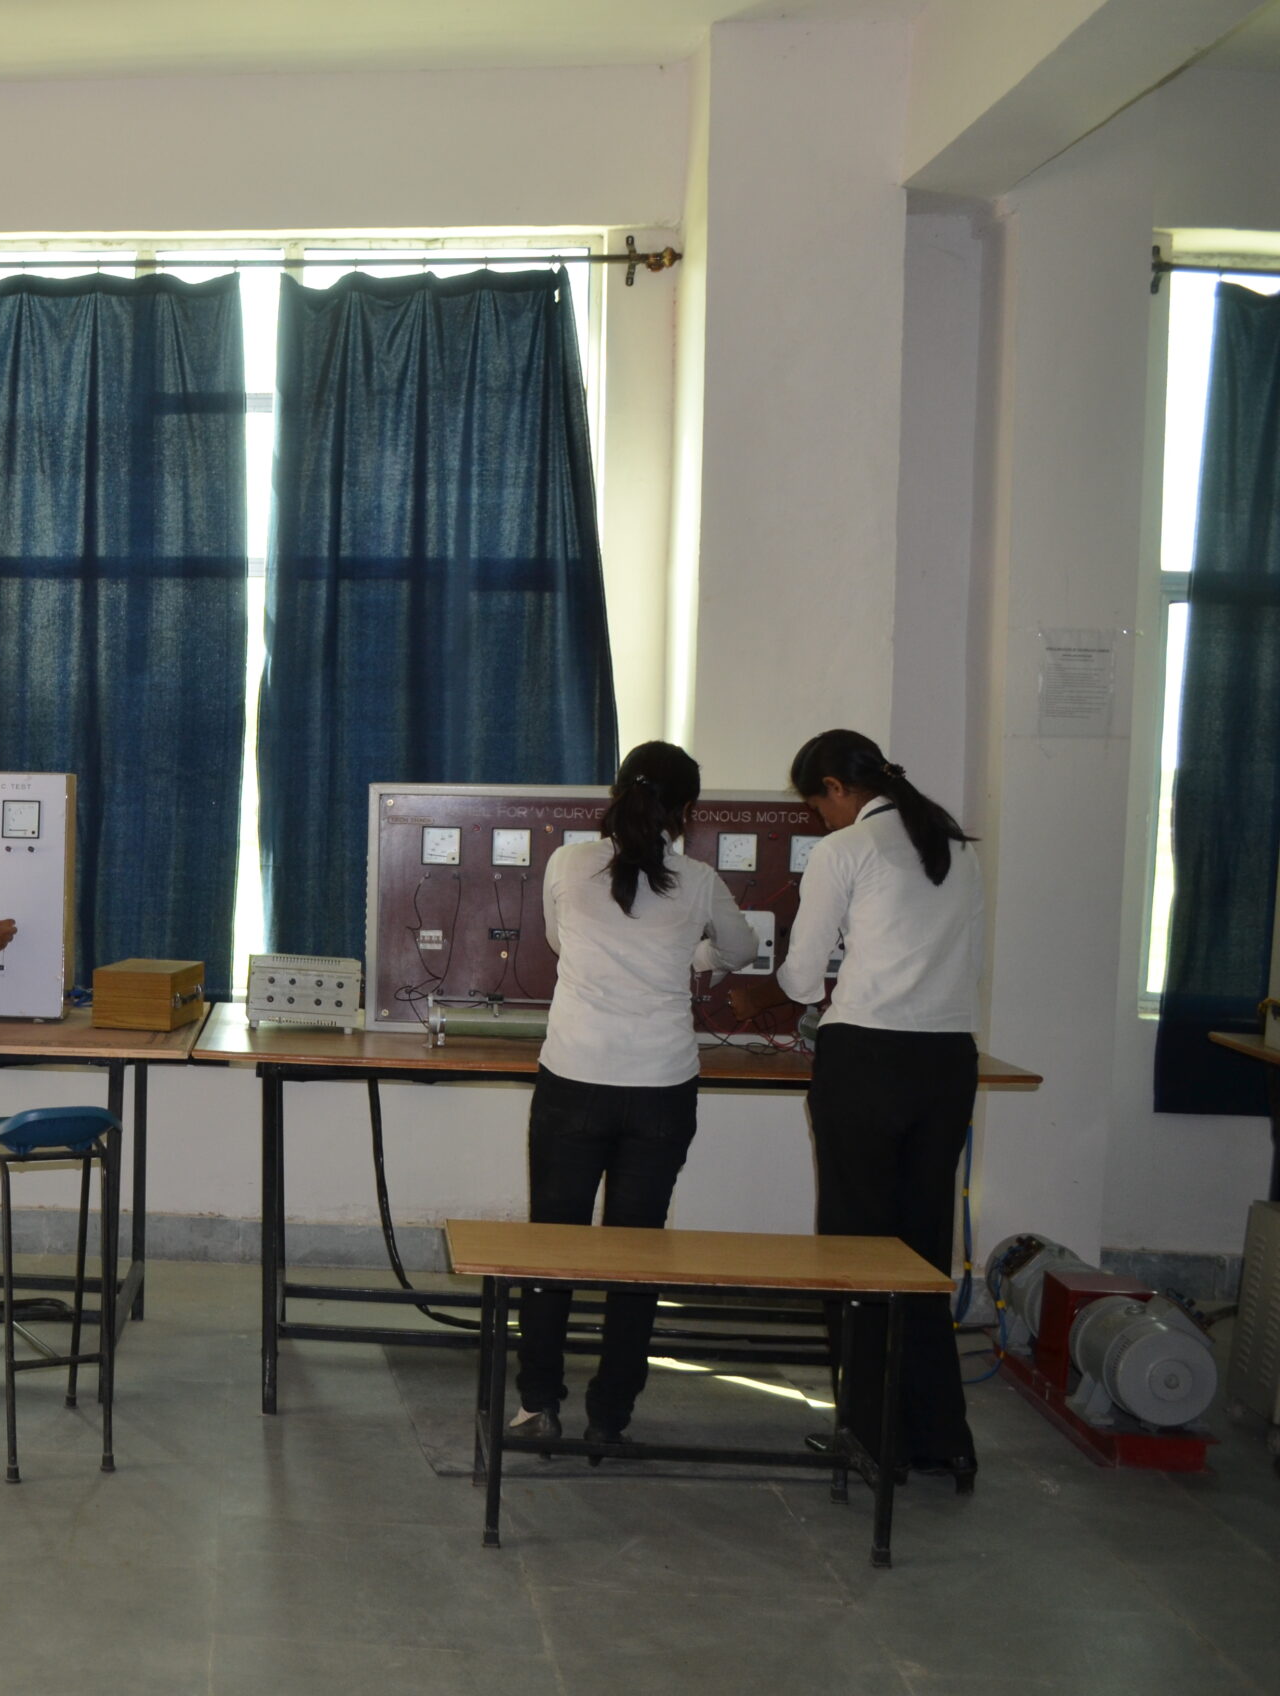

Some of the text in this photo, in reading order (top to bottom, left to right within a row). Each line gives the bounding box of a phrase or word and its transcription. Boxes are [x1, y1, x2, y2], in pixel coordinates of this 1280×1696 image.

[497, 805, 528, 818] FOR
[553, 806, 606, 820] CURVE
[756, 810, 810, 824] MOTOR
